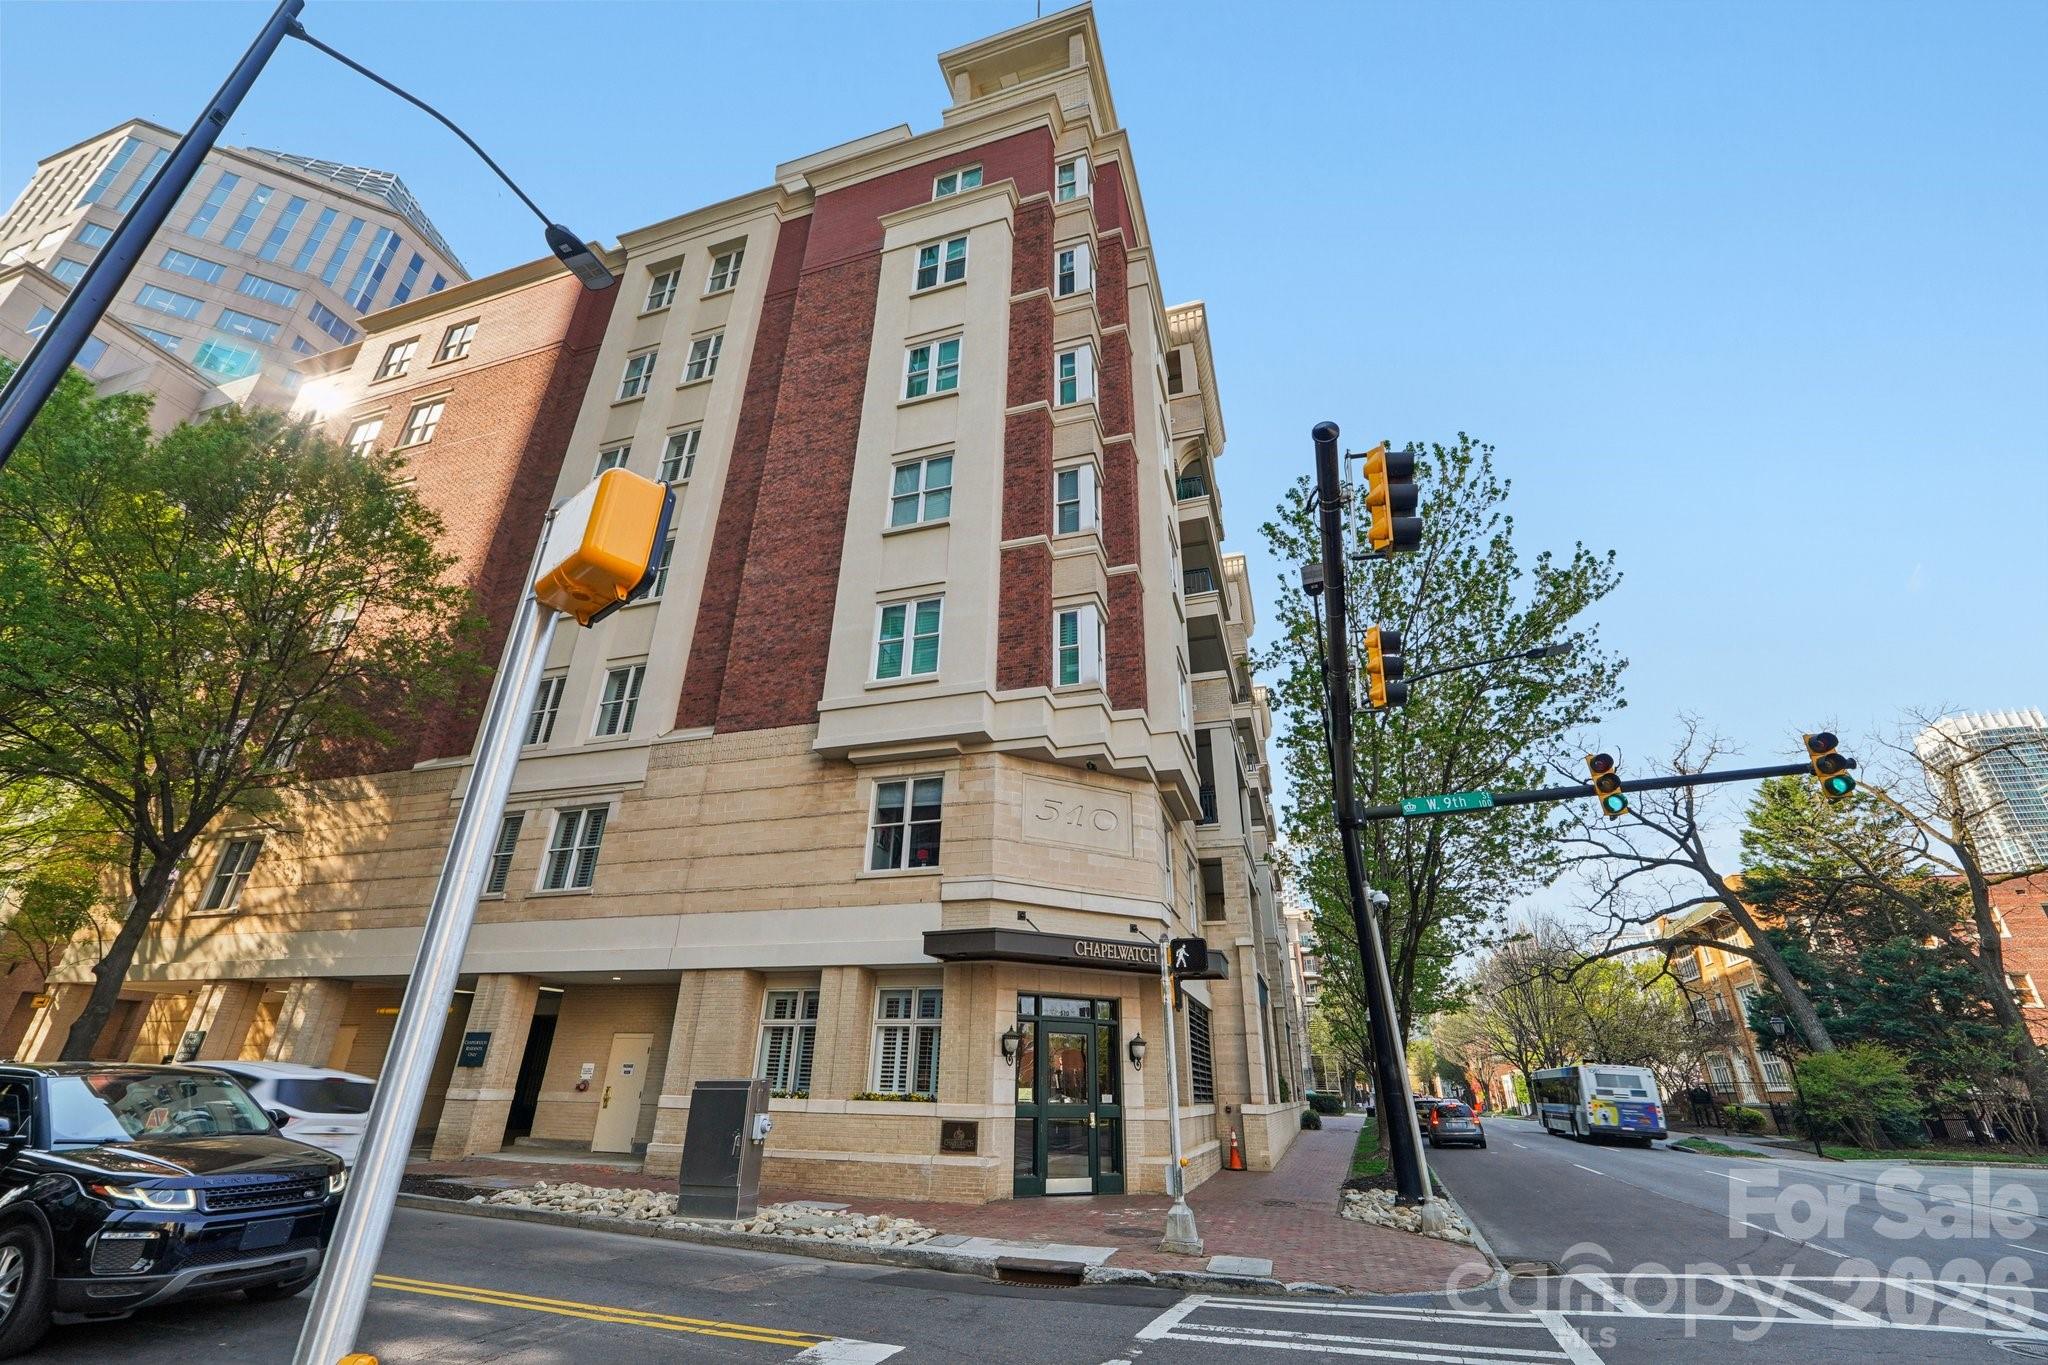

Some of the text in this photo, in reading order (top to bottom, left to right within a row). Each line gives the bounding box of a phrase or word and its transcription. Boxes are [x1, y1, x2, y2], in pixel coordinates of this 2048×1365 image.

[1426, 796, 1467, 810] W. 9th
[1478, 799, 1492, 807] 100
[1075, 940, 1158, 963] CHAPELWATCH
